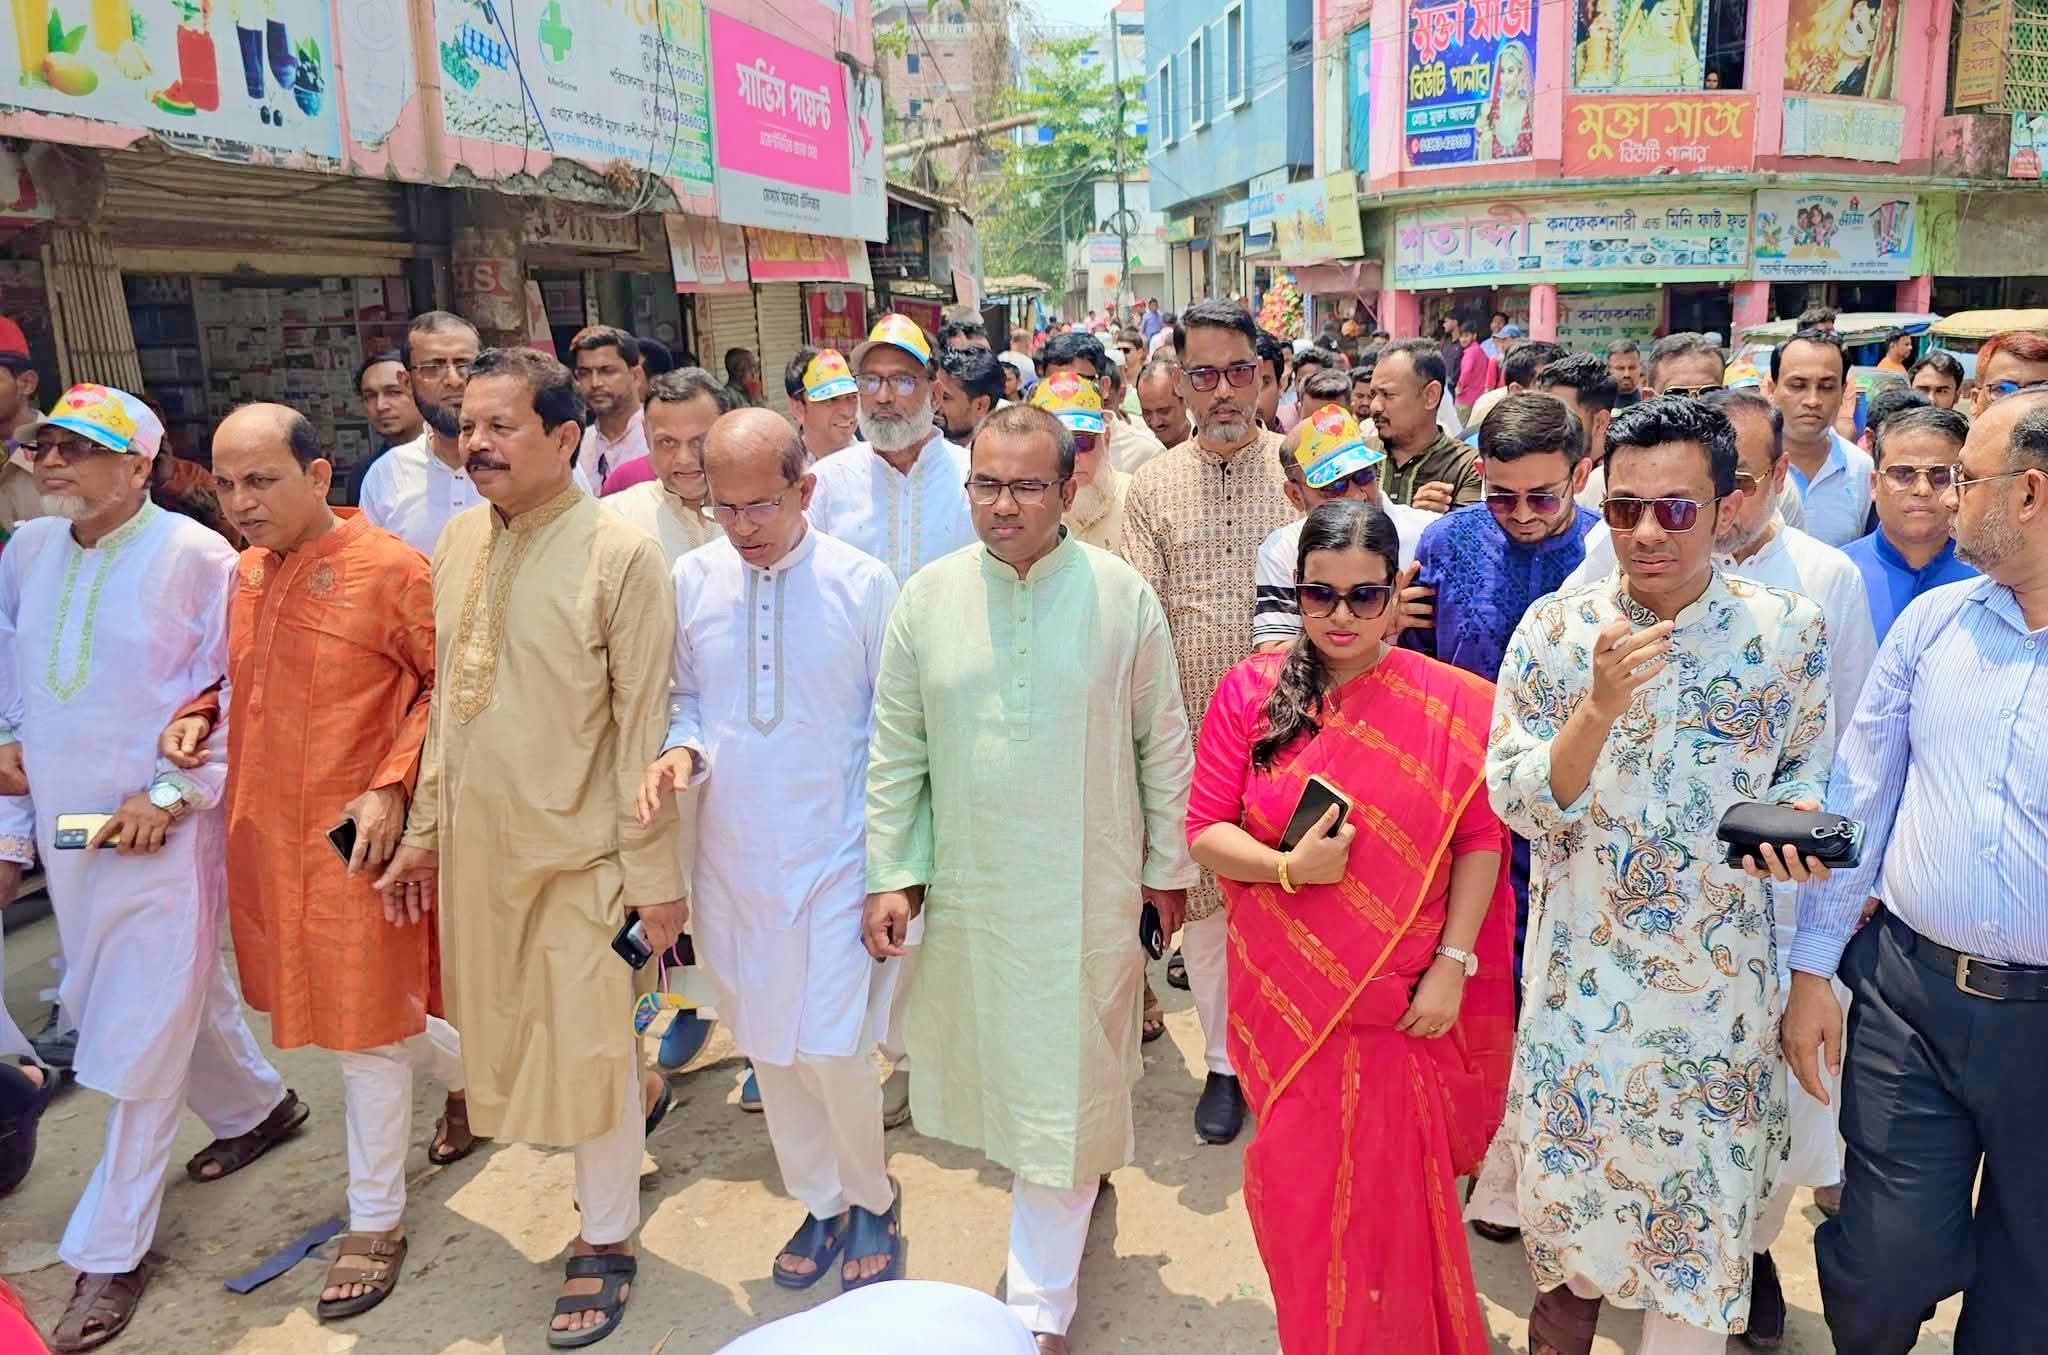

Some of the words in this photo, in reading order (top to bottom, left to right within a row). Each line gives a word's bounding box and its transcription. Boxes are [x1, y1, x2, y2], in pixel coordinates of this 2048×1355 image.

[1412, 2, 1467, 64] মুক্তা
[1470, 0, 1533, 42] সাজ
[736, 58, 787, 117] সার্ভিস
[790, 84, 831, 131] পয়েন্ট
[1410, 61, 1446, 100] বিউটি
[1450, 52, 1490, 96] পার্লার
[1571, 103, 1661, 161] মুক্তা
[1661, 101, 1751, 139] সাজ
[1618, 138, 1660, 163] বিউটি
[1666, 141, 1710, 163] পার্লার
[1399, 203, 1537, 262] শতাব্দী
[1546, 208, 1637, 233] কনফেকশনারী
[1666, 208, 1694, 232] মিনি
[1727, 213, 1748, 233] ফুড
